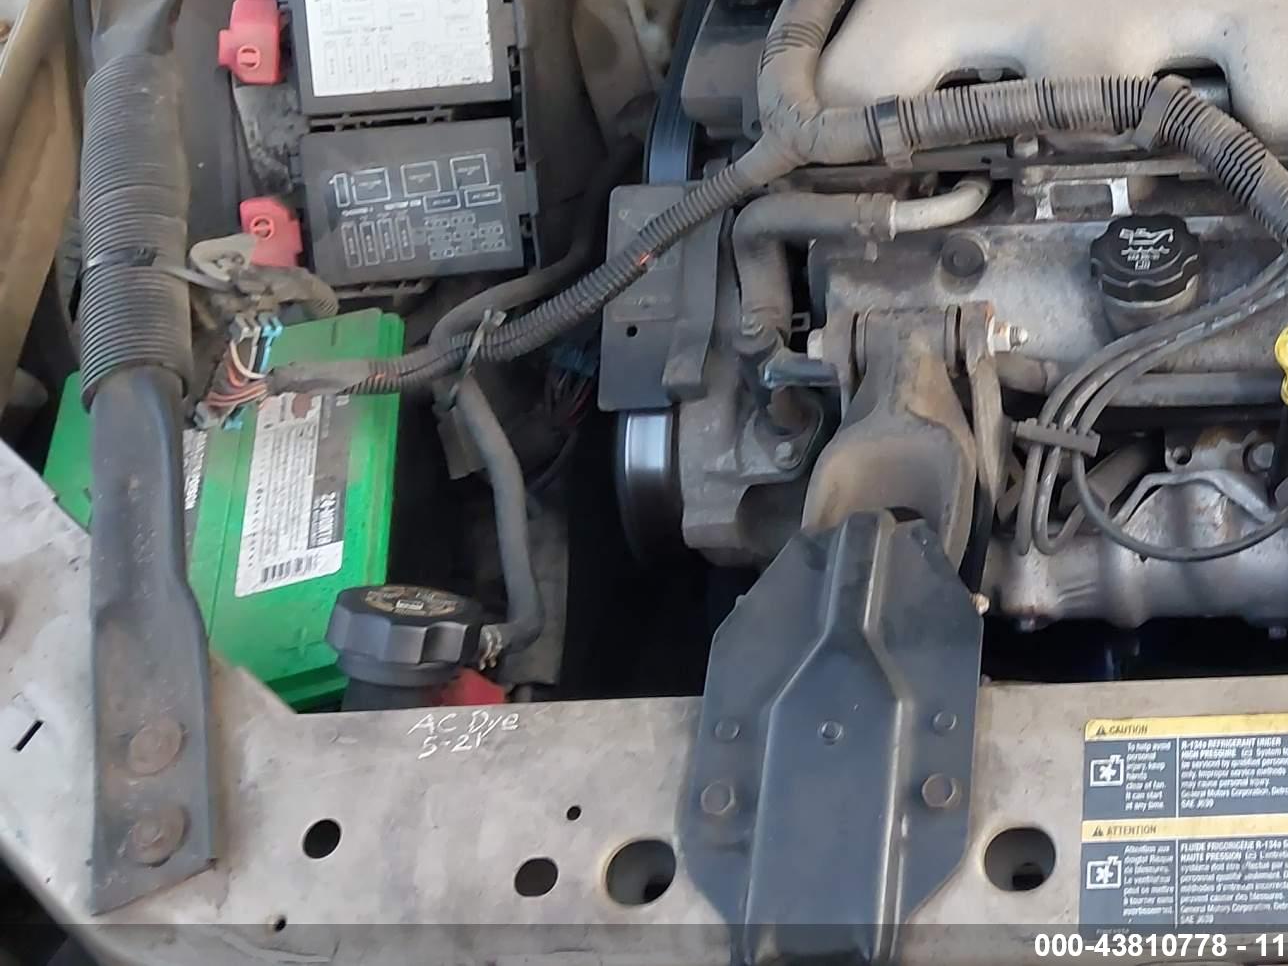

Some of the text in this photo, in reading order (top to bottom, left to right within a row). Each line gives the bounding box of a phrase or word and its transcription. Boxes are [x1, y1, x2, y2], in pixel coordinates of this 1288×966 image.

[407, 709, 520, 738] AC Dye
[1108, 725, 1148, 735] CAUTION
[1207, 788, 1230, 798] Motors
[1106, 826, 1156, 836] ATTENTION
